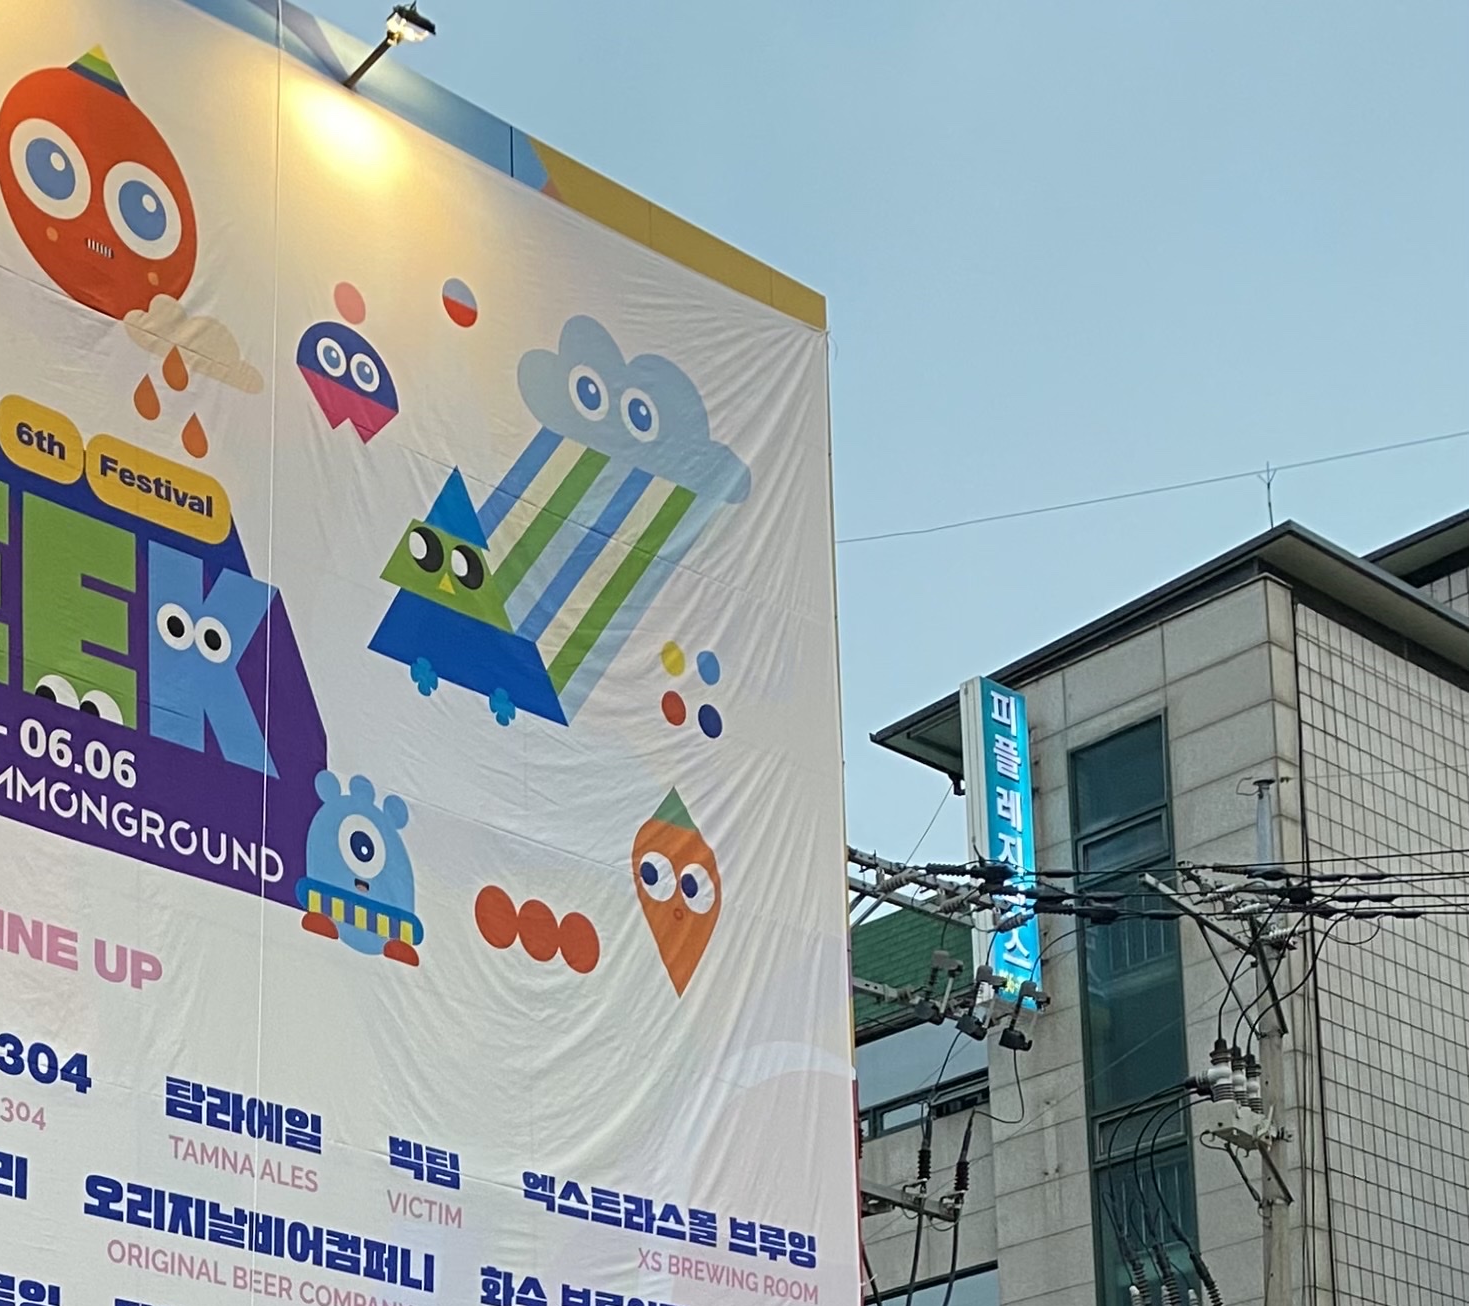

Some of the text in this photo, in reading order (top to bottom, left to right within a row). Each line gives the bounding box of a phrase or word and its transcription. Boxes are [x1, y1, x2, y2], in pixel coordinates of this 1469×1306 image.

[14, 421, 214, 519] 6th Festival
[19, 717, 137, 789] 06.06
[990, 689, 1033, 970] 피플레지스
[94, 938, 164, 990] UP
[0, 1096, 47, 1132] 304
[165, 1075, 322, 1155] 탐라에일
[168, 1134, 319, 1193] TAMNA ALES
[388, 1135, 461, 1191] 빅팀
[83, 1173, 435, 1294] 오리지날비어컴퍼니
[386, 1188, 463, 1229] VICTIM
[521, 1170, 818, 1270] 엑스트라스몰 브루잉
[107, 1238, 227, 1286] ORIGINAL
[232, 1265, 293, 1301] BEER
[637, 1246, 819, 1306] XS BREWING ROOM
